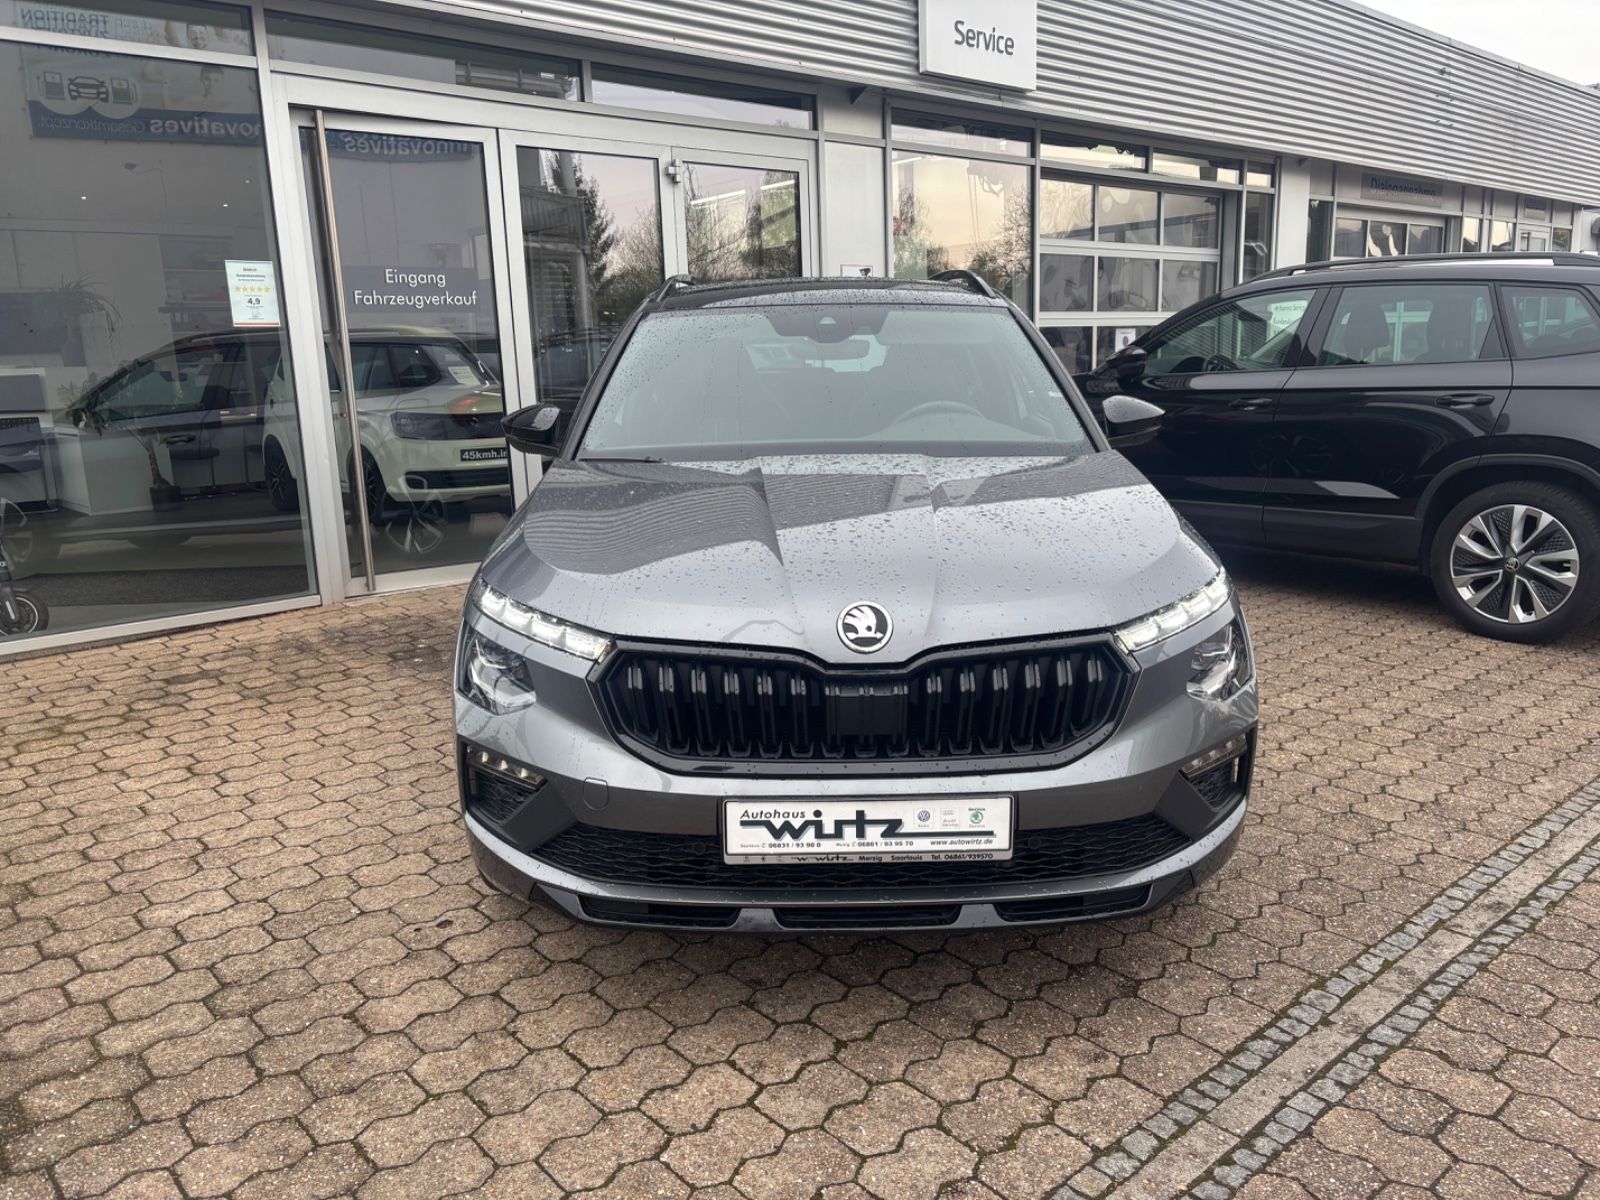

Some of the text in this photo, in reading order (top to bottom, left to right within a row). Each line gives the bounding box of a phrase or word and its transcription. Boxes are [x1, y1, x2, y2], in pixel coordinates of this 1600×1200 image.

[954, 19, 1014, 56] Service
[384, 268, 446, 288] Eingang
[247, 297, 261, 306] 4,9
[353, 290, 477, 309] Fahrzeugverkauf
[740, 809, 806, 819] Autohaus
[930, 838, 993, 846] www.autowirtz.de
